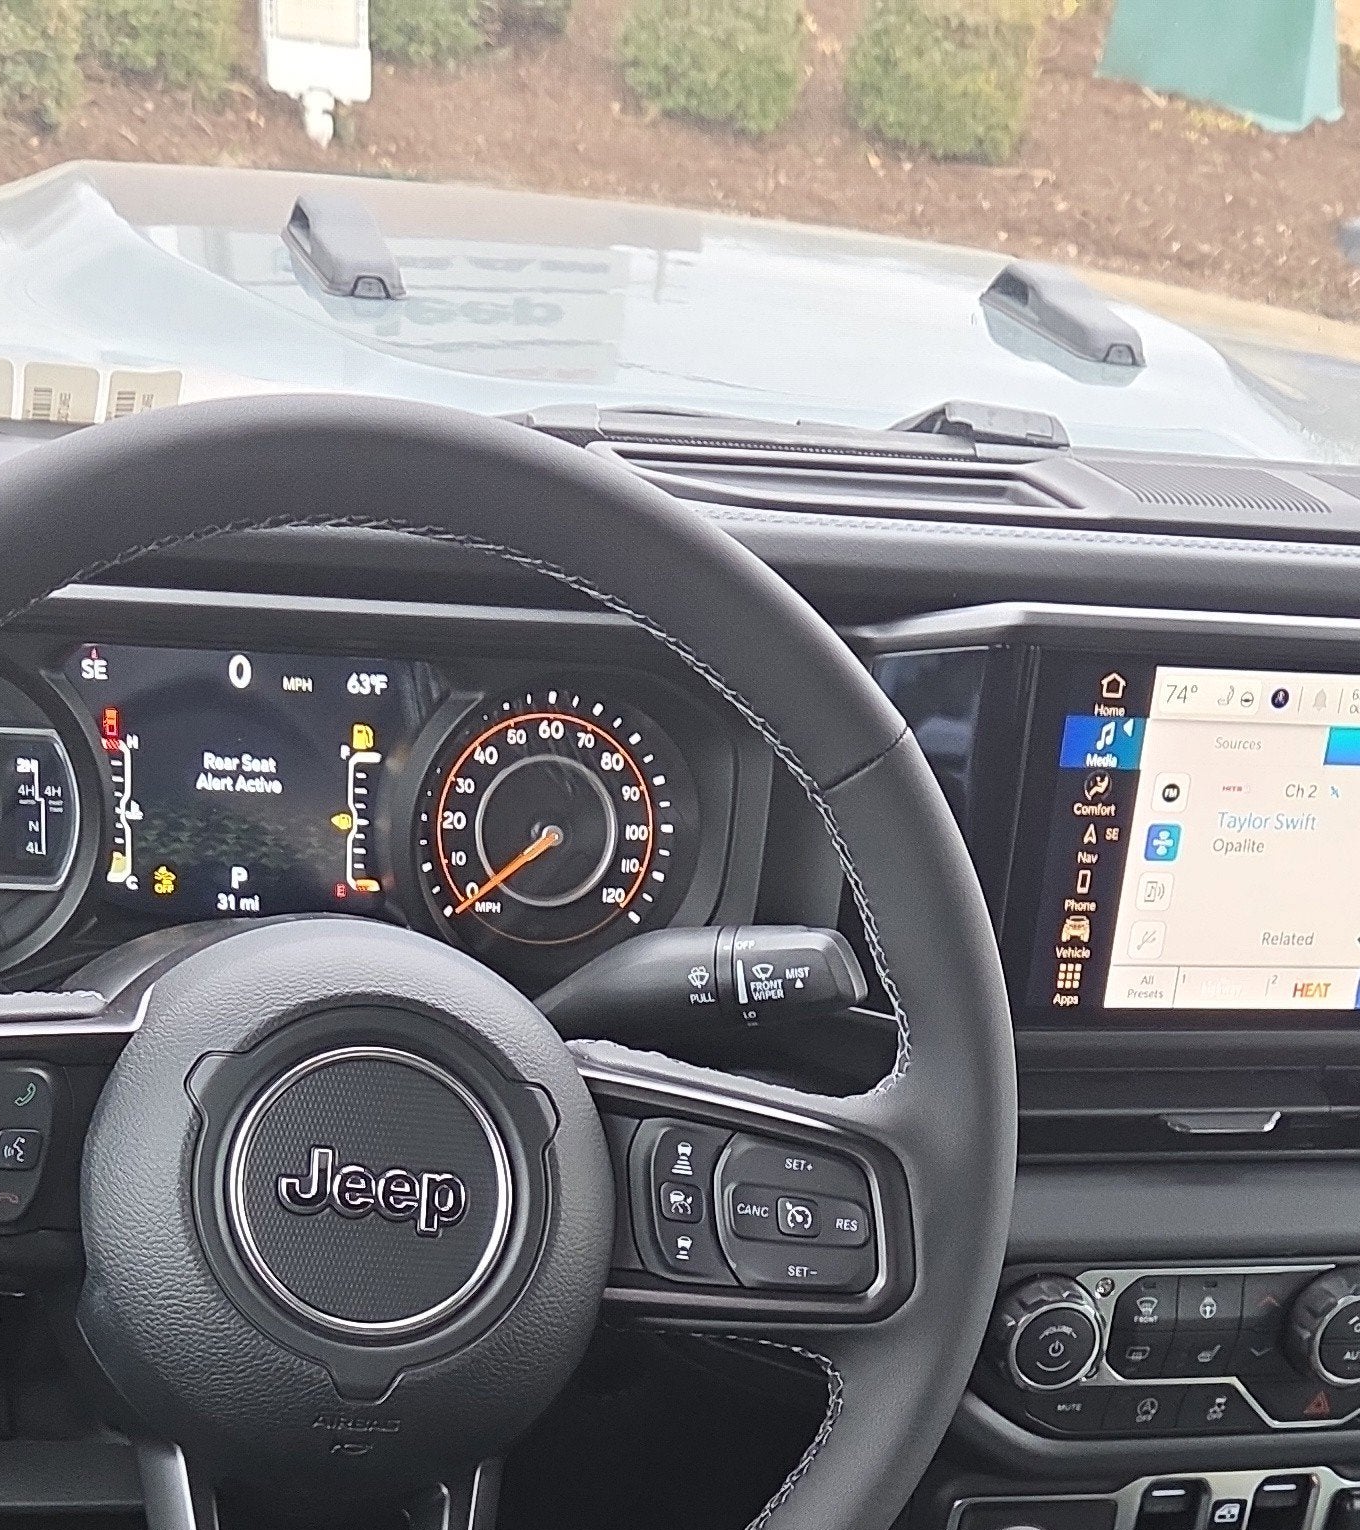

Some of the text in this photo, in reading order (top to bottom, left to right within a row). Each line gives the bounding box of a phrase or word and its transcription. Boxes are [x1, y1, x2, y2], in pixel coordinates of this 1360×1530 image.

[81, 659, 108, 680] SE
[229, 654, 313, 693] 0 MPH
[346, 673, 388, 695] 63°F
[1166, 685, 1199, 706] 74°
[1094, 703, 1125, 717] Home
[507, 729, 527, 745] 50
[538, 720, 564, 739] 60
[127, 735, 139, 750] H
[577, 733, 595, 749] 70
[1215, 736, 1262, 752] Sources
[203, 752, 277, 773] Rear Seat
[473, 745, 498, 765] 40
[600, 752, 624, 772] 80
[1085, 753, 1118, 768] Media
[18, 784, 35, 797] 4H
[44, 785, 61, 797] 4H
[196, 773, 282, 794] Alert Active
[455, 778, 475, 794] 30
[1285, 784, 1318, 798] Ch 2
[621, 784, 640, 801] 90
[1073, 803, 1116, 816] Comfort
[28, 820, 40, 832] N
[442, 811, 466, 830] 20
[1218, 811, 1317, 833] Taylor Swift
[625, 824, 648, 841] 100
[1105, 828, 1120, 841] SE
[1212, 838, 1265, 855] Opalite
[451, 851, 466, 866] 10
[621, 857, 640, 873] 110
[1077, 851, 1099, 864] Nav
[126, 875, 138, 890] C
[231, 866, 248, 889] P
[466, 882, 479, 898] 0
[602, 887, 625, 904] 120
[217, 893, 260, 912] 31 mi
[474, 901, 501, 914] MPH
[1064, 899, 1097, 912] Phone
[1261, 932, 1314, 946] Related
[1056, 946, 1091, 959] Vehicle
[785, 966, 810, 980] MIST
[1140, 975, 1154, 985] All
[1271, 974, 1279, 984] 2
[750, 979, 784, 992] FRONT
[1292, 982, 1332, 998] HEAT
[690, 992, 716, 1004] PULL
[752, 989, 784, 1001] WIPER
[1053, 993, 1079, 1007] Apps
[1127, 987, 1164, 1000] Presets
[743, 1011, 757, 1020] LO
[278, 1144, 467, 1237] Jeep
[737, 1203, 769, 1218] CANC
[836, 1218, 858, 1232] RES
